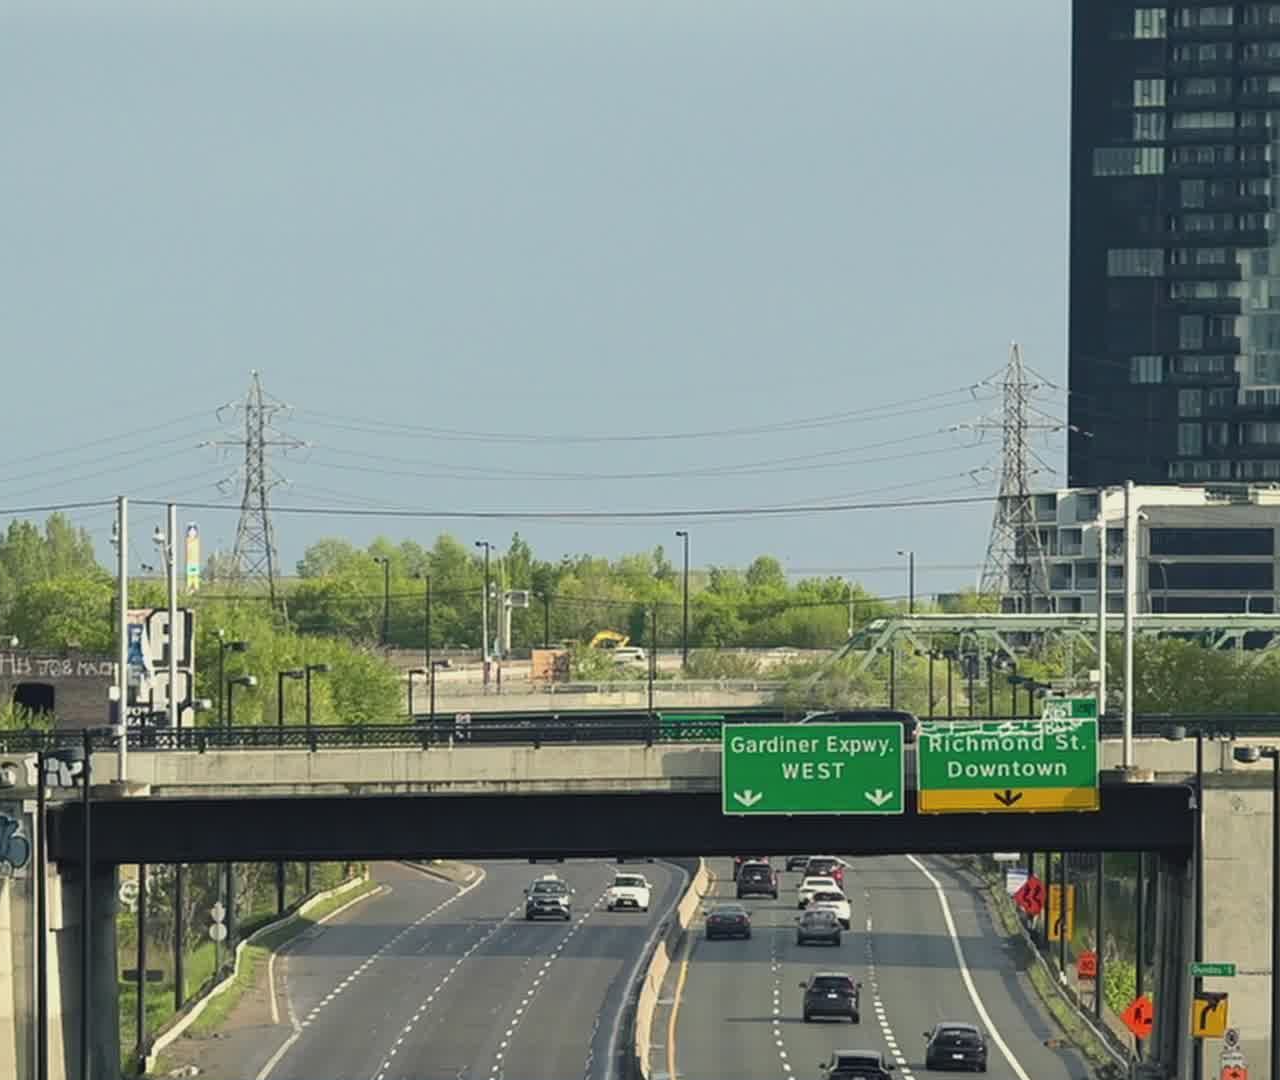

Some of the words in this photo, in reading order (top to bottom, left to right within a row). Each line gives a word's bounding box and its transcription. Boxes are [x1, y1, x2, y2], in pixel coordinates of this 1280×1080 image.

[730, 735, 819, 754] Gardiner
[826, 736, 895, 757] Expwy.
[928, 733, 1045, 752] Richmond
[1055, 733, 1087, 751] St.
[782, 761, 846, 780] WEST
[947, 761, 1069, 778] Downtown
